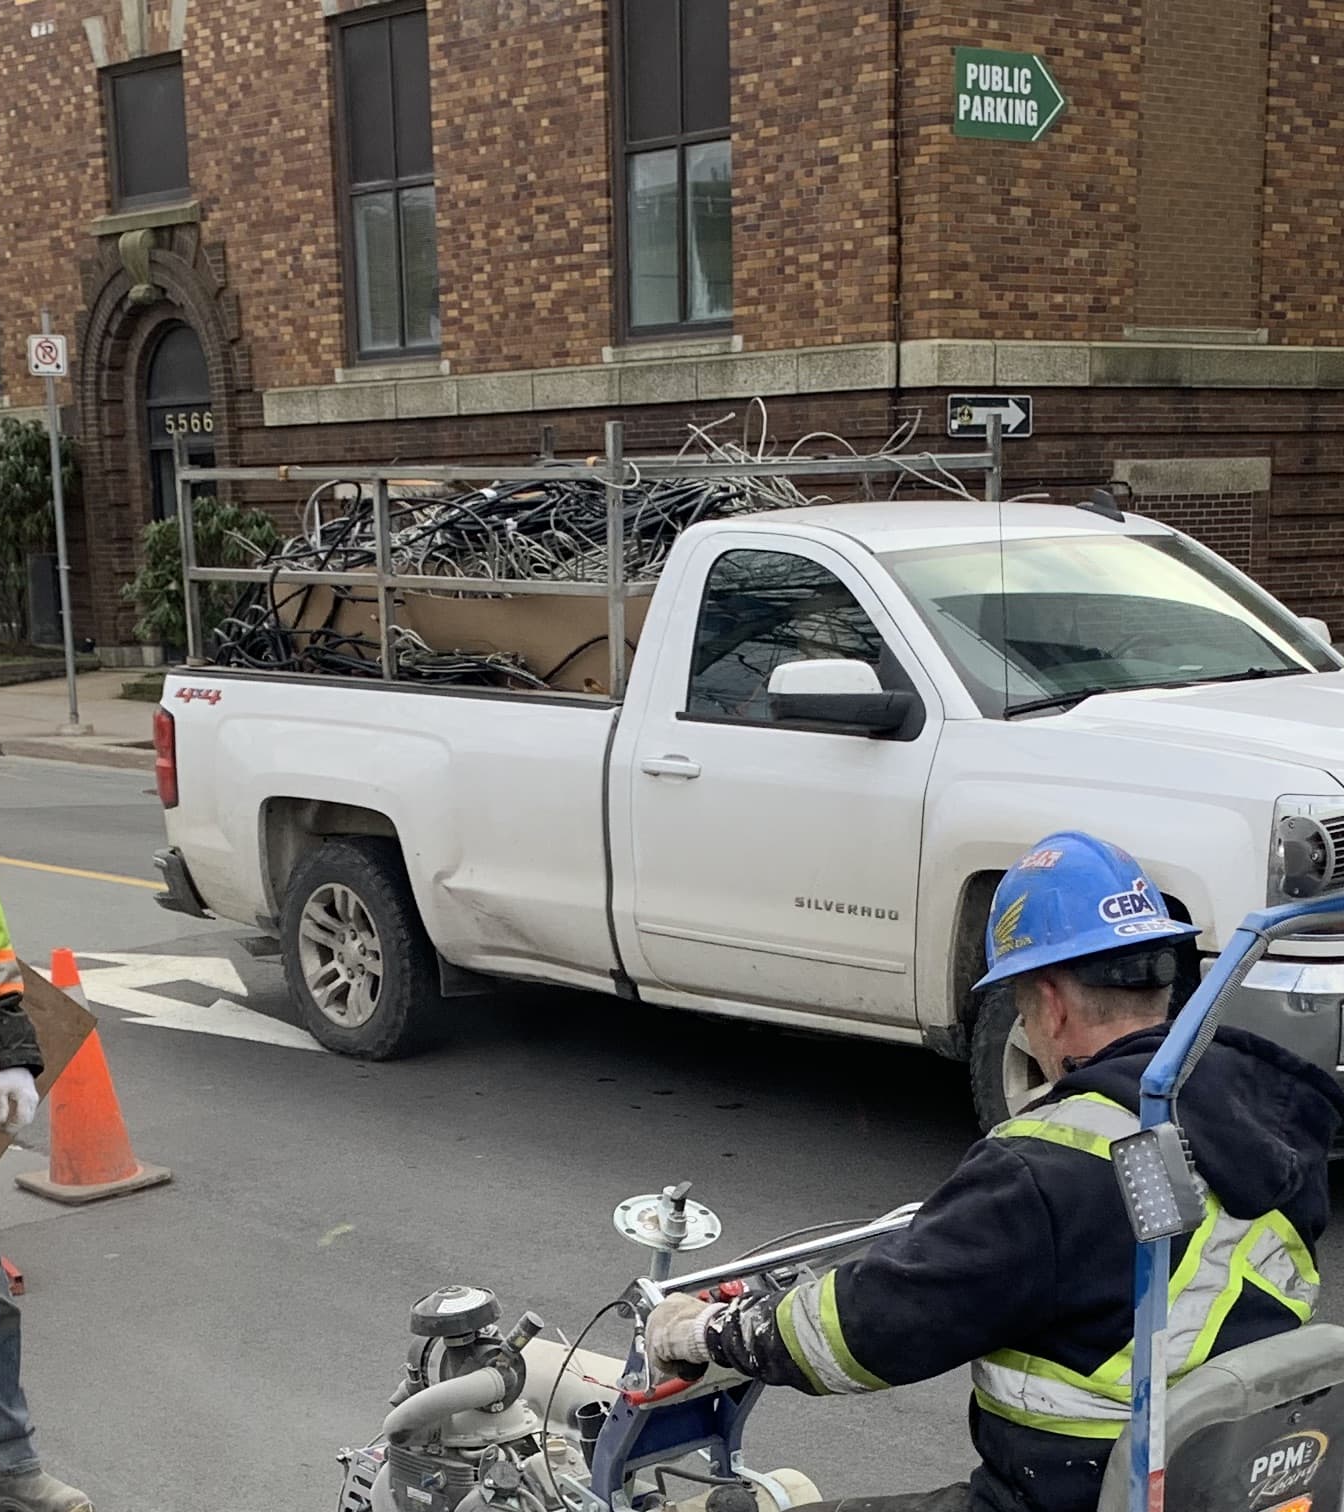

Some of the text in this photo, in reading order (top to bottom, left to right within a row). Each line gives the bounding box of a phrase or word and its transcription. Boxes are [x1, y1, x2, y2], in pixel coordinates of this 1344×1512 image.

[966, 63, 1032, 95] PUBLIC
[959, 94, 1038, 126] PARKING
[165, 411, 214, 434] 5566
[794, 896, 899, 921] SILVERADO
[1102, 892, 1155, 920] CEDA
[1251, 1442, 1305, 1482] PPM
